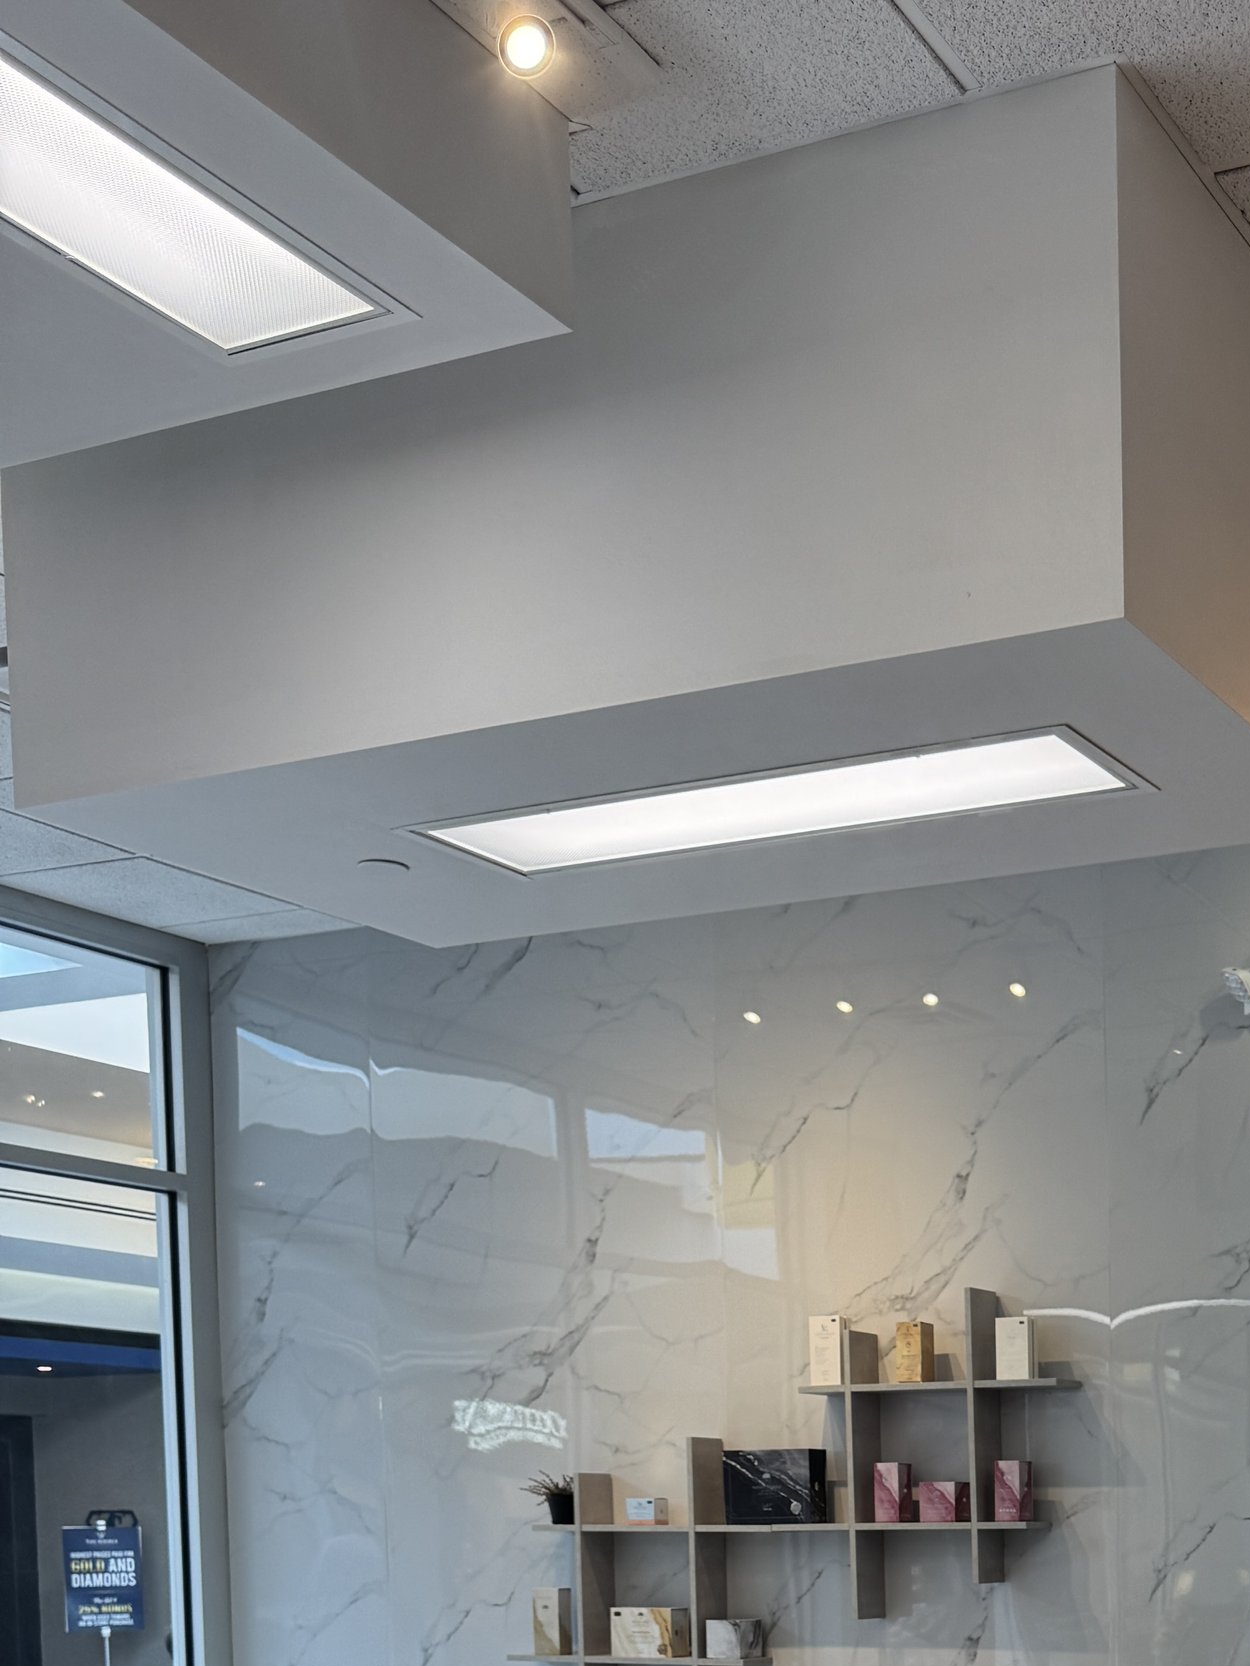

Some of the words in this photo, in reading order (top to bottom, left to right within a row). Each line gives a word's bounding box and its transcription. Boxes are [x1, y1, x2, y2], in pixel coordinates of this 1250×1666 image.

[71, 1560, 105, 1572] GOLD
[108, 1558, 135, 1572] AND
[71, 1572, 137, 1588] DIAMONDS
